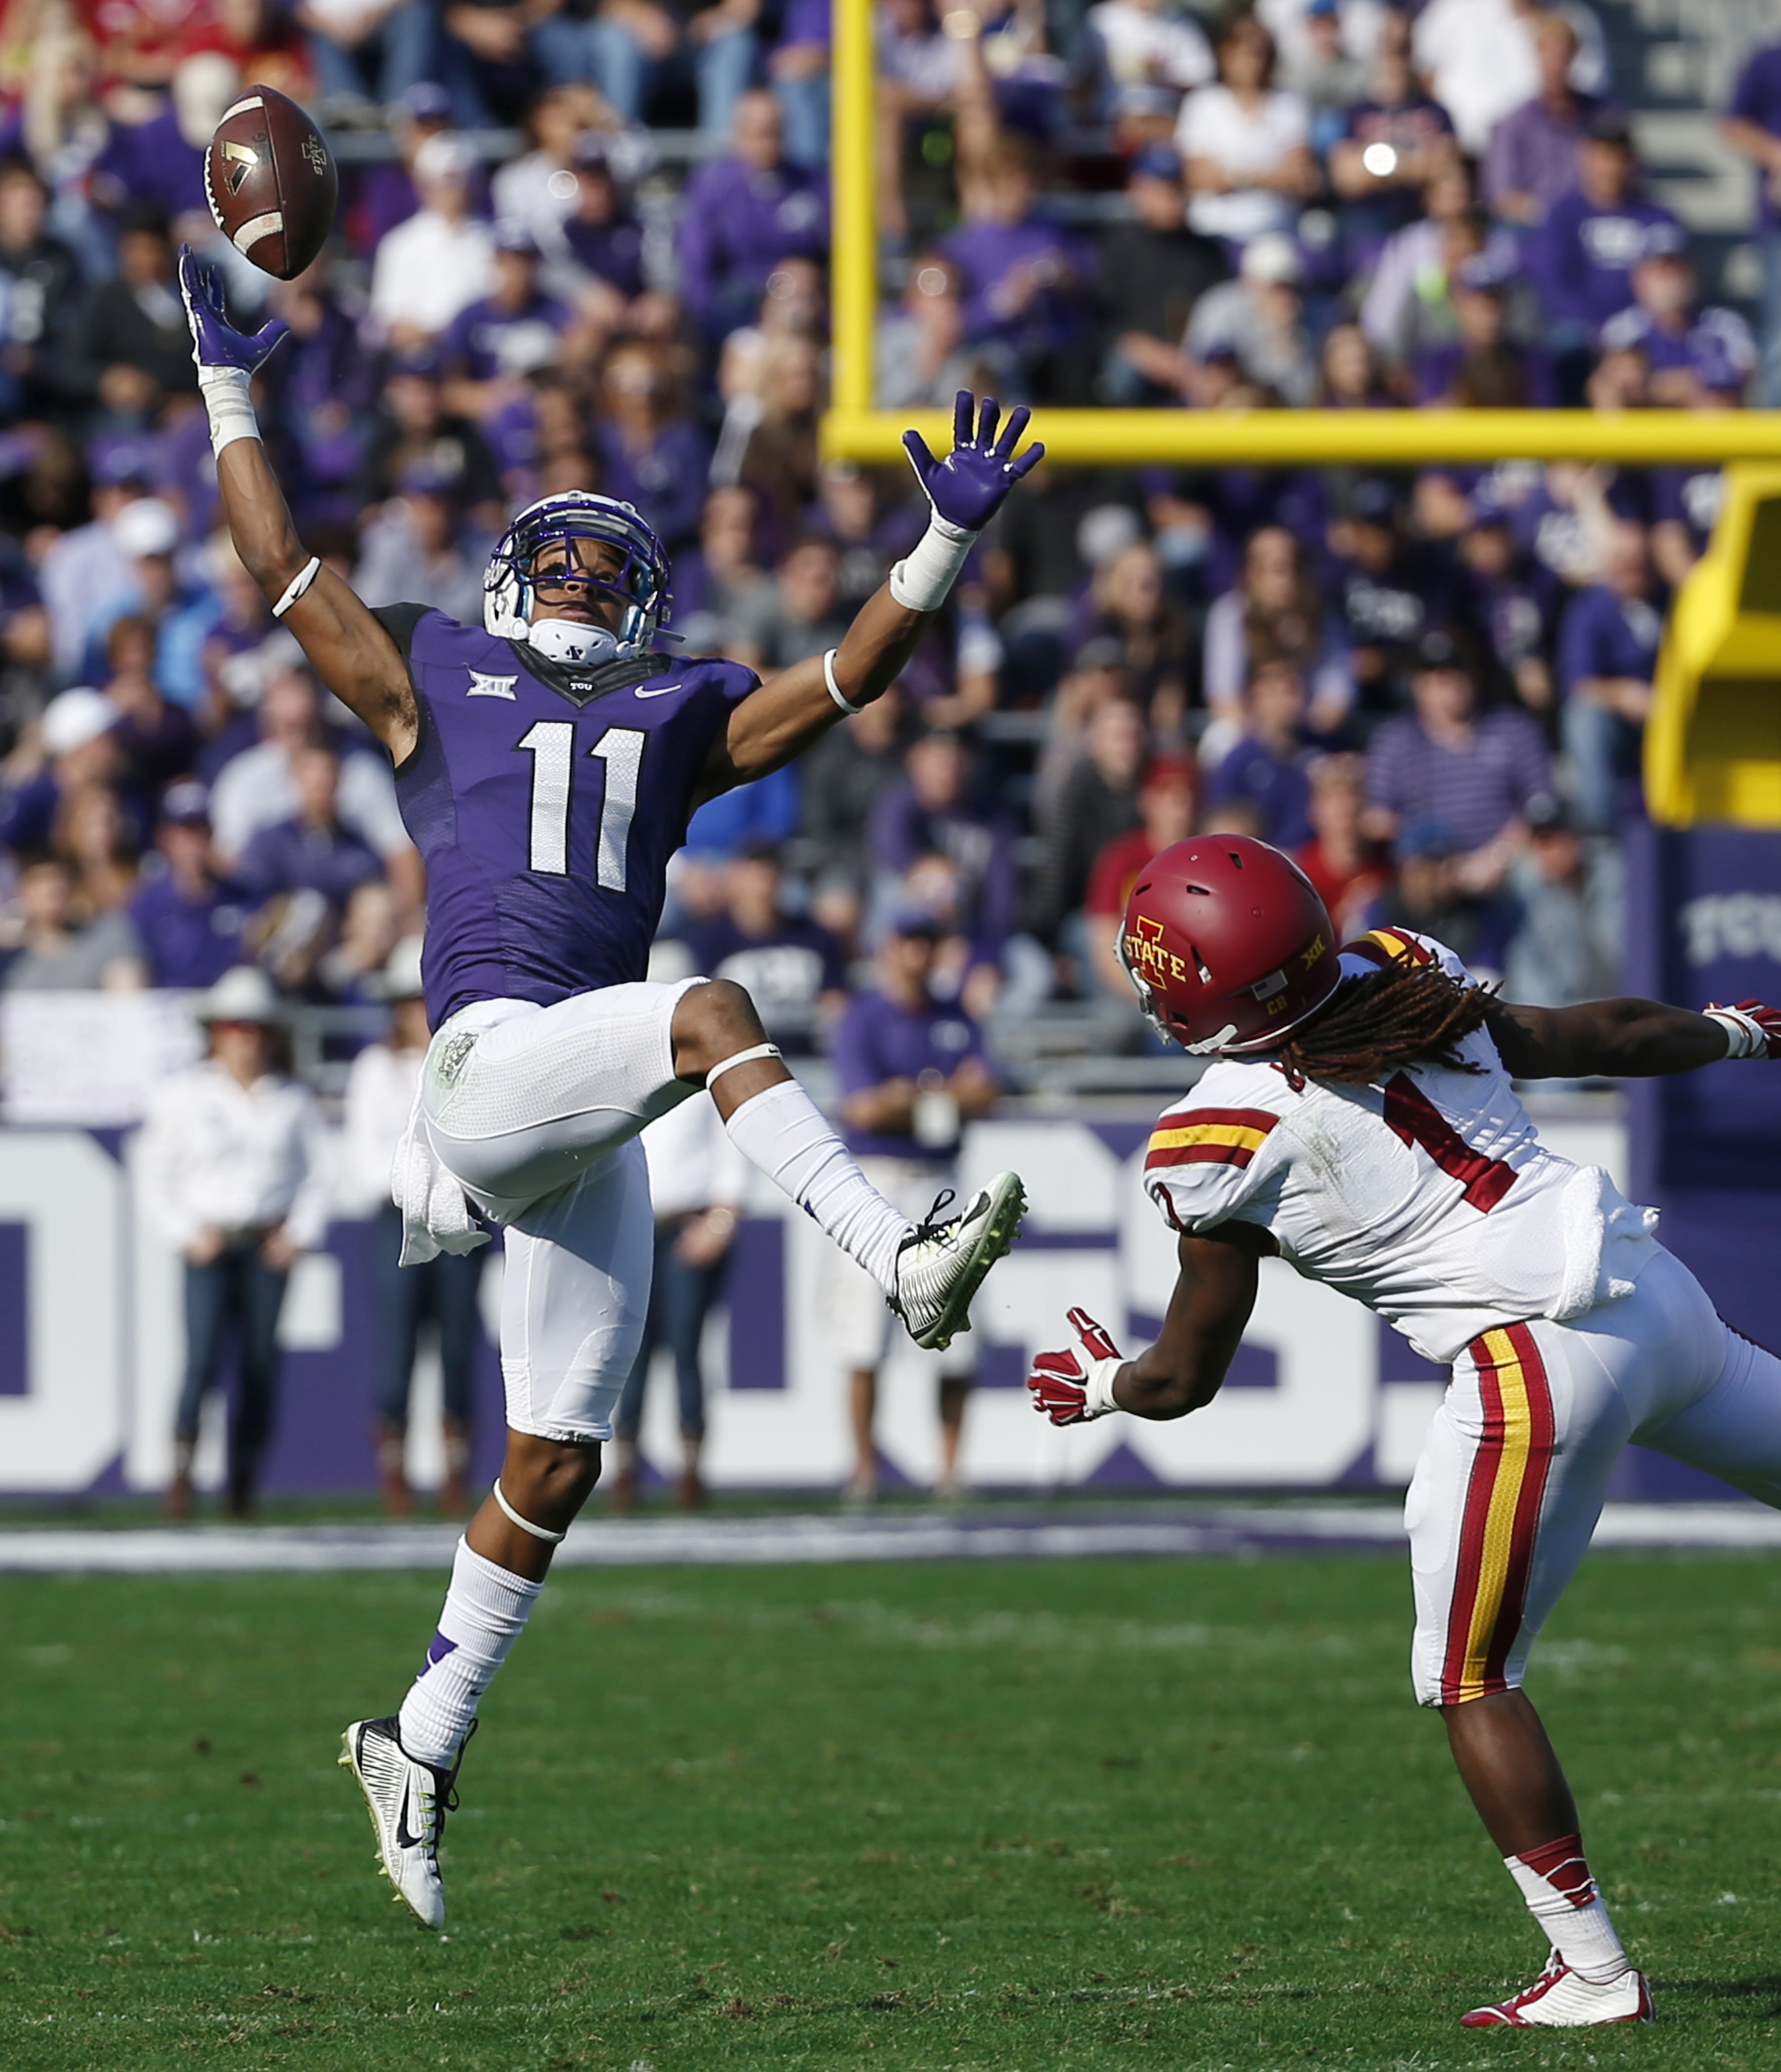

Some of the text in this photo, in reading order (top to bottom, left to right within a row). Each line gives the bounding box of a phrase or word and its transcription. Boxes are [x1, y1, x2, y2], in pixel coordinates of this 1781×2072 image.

[309, 134, 323, 176] STATE
[569, 682, 593, 691] TCU
[516, 721, 646, 894] 11
[1125, 935, 1186, 983] STATE
[1266, 995, 1287, 1016] CB
[1383, 1070, 1519, 1214] 1
